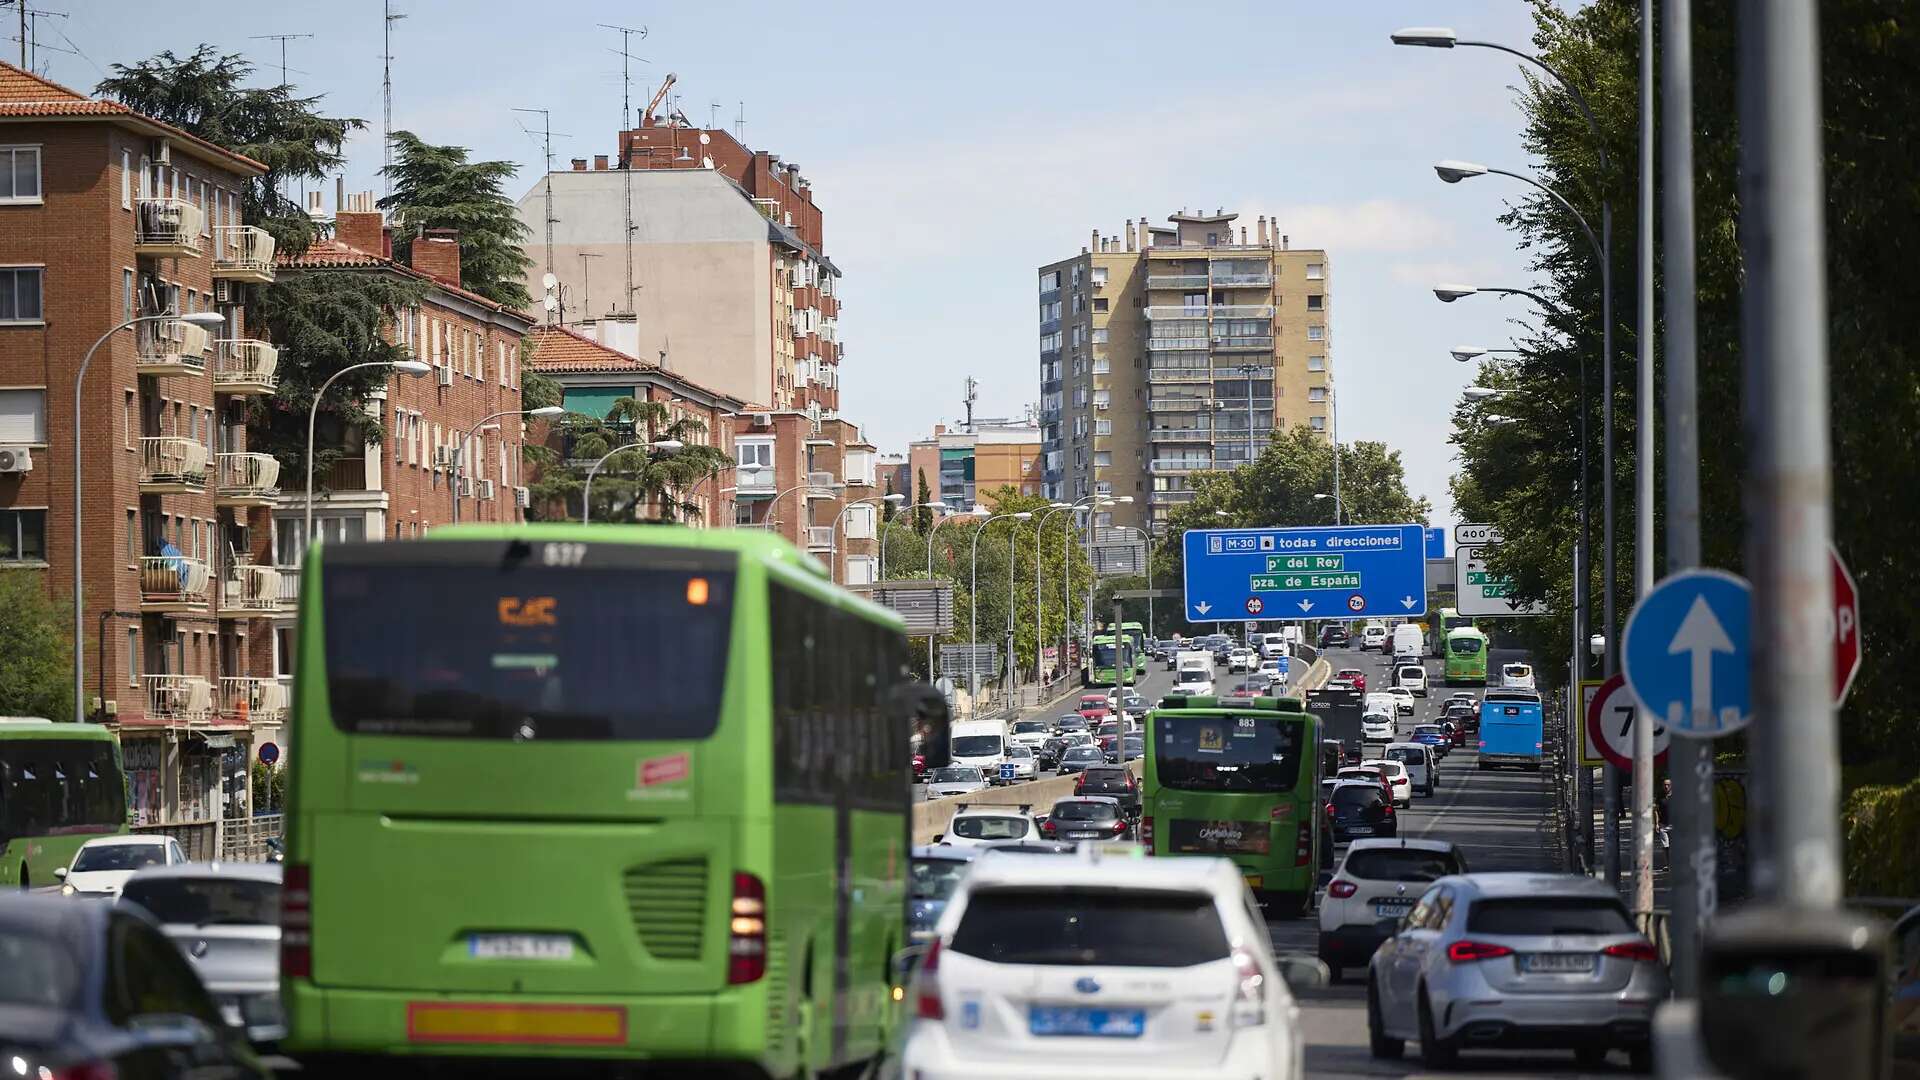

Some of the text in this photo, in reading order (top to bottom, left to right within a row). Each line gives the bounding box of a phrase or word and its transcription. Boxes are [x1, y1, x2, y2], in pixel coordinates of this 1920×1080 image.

[1462, 530, 1486, 538] 400
[1228, 535, 1400, 548] M-30 todas direcciones
[1287, 557, 1309, 568] del
[1316, 557, 1340, 569] Rey
[1252, 574, 1359, 589] pza. de España
[1238, 718, 1255, 728] 883
